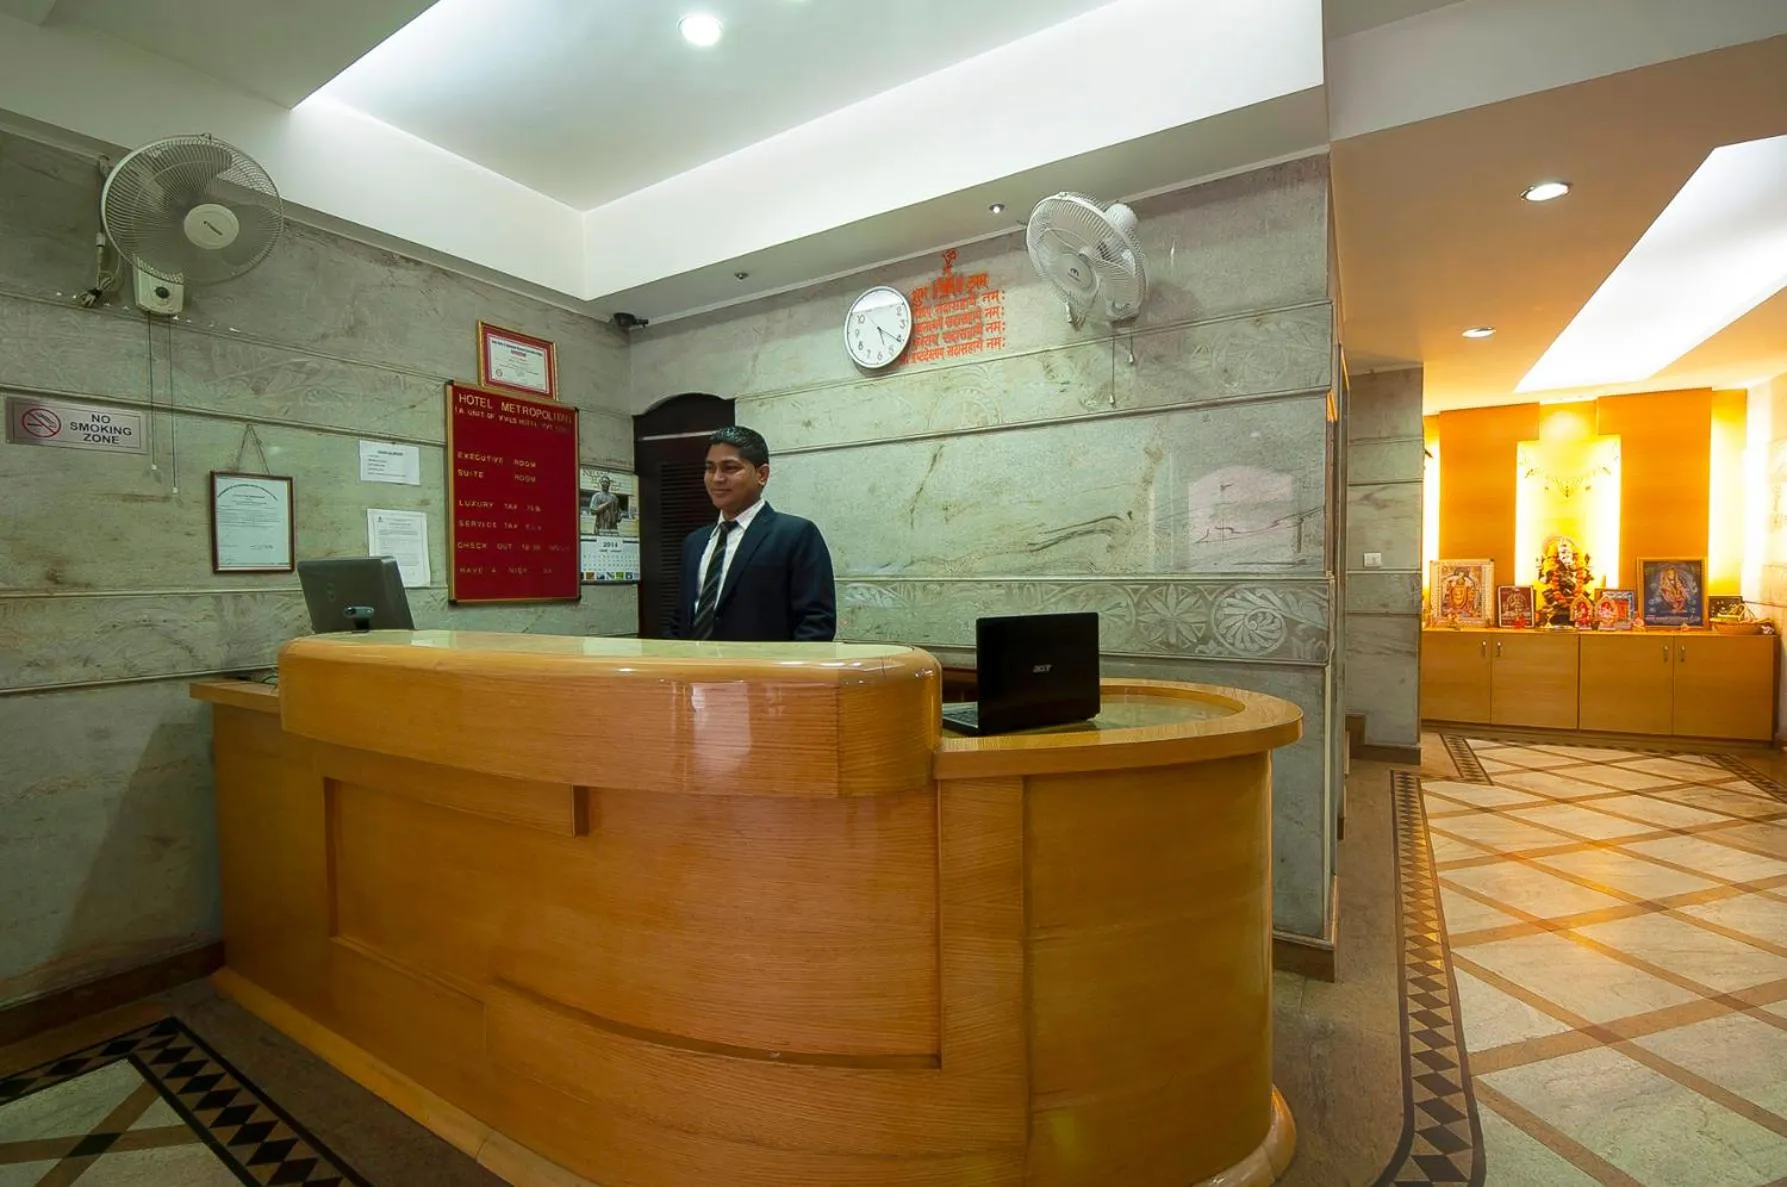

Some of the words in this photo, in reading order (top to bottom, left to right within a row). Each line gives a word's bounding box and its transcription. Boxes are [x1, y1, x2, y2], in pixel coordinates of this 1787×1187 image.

[857, 313, 866, 325] 10
[877, 351, 883, 361] 6
[458, 393, 493, 410] HOTEL
[91, 414, 111, 424] NO
[69, 421, 133, 437] SMOKING
[83, 433, 120, 444] ZONE
[457, 450, 504, 465] EXECUTIVE
[513, 459, 537, 469] ROOM
[457, 468, 485, 479] SUITE
[514, 473, 537, 483] ROOM
[458, 499, 495, 509] LUXURY
[504, 503, 518, 511] TAX
[458, 519, 497, 529] SERVICE
[504, 521, 518, 530] TAX
[457, 541, 488, 550] CHECK
[496, 543, 513, 551] OUT
[459, 566, 483, 575] HAVE
